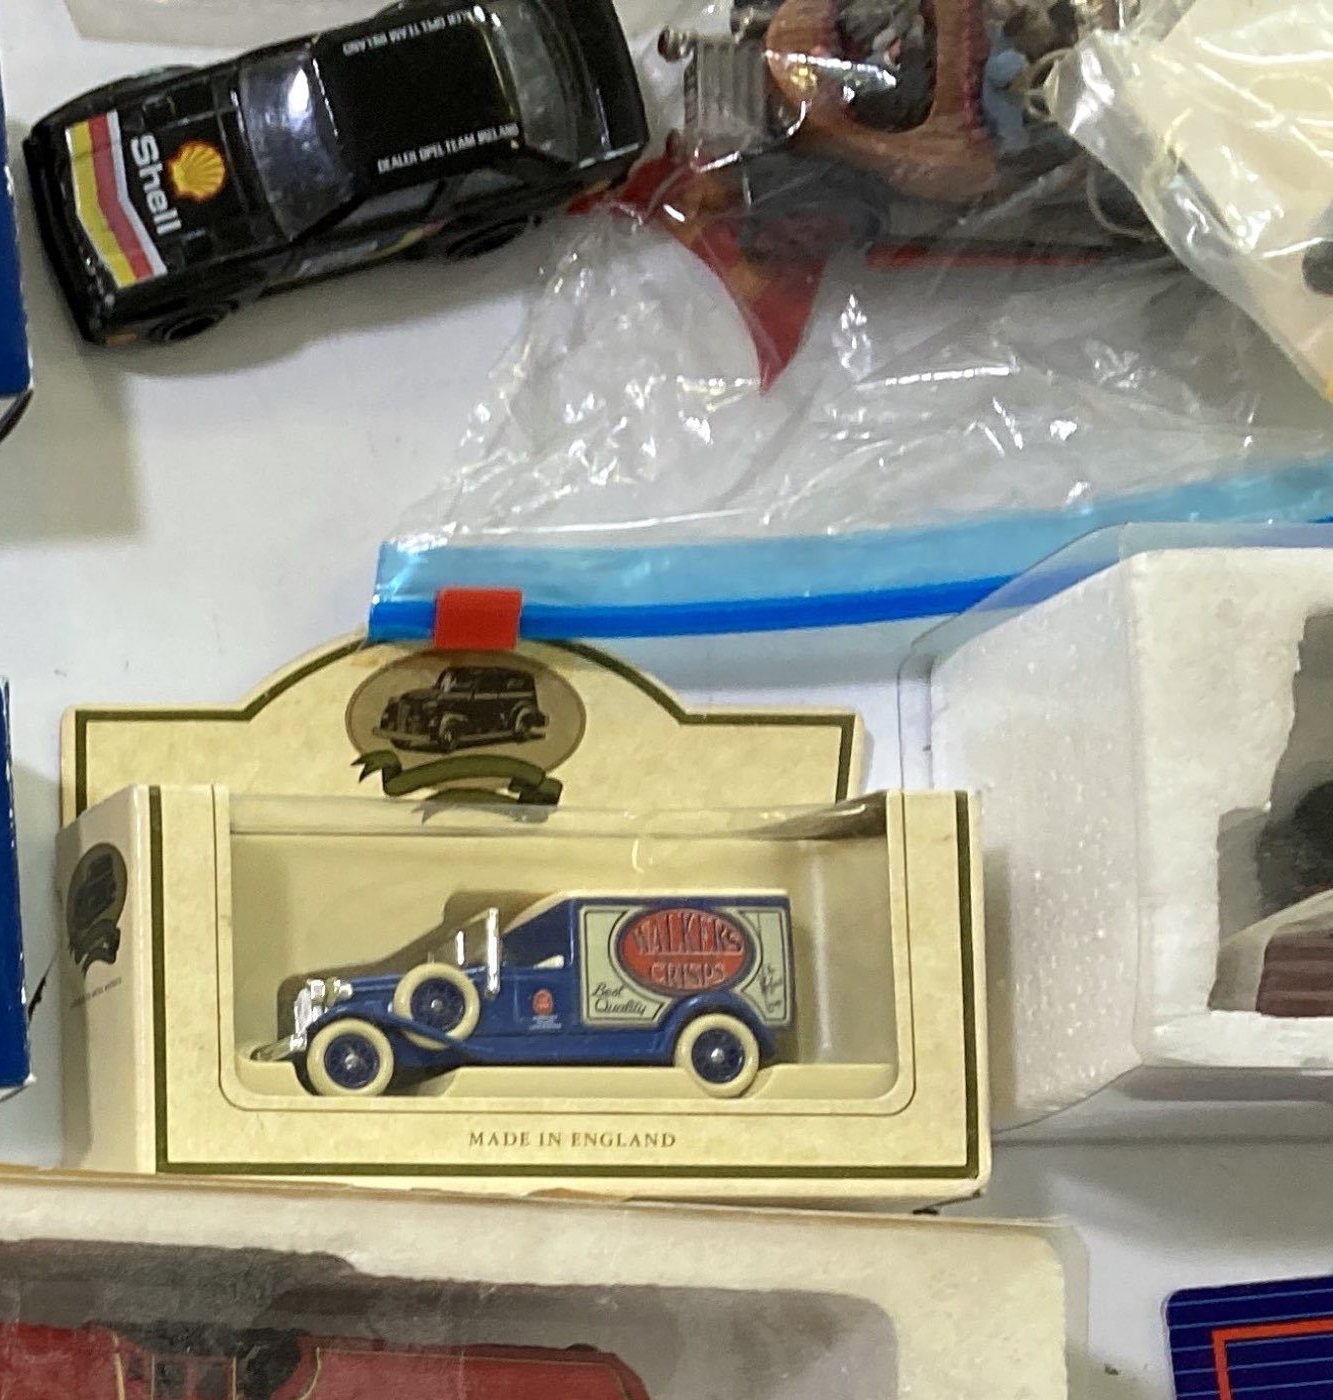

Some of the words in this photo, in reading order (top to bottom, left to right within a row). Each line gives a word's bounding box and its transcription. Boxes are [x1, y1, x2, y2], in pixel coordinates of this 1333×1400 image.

[445, 132, 477, 154] TEAM
[130, 133, 183, 237] Shell
[591, 983, 625, 998] Best
[594, 999, 648, 1017] Quality
[469, 1131, 531, 1148] MADE
[539, 1131, 562, 1148] IN
[571, 1131, 676, 1149] ENGLAND
